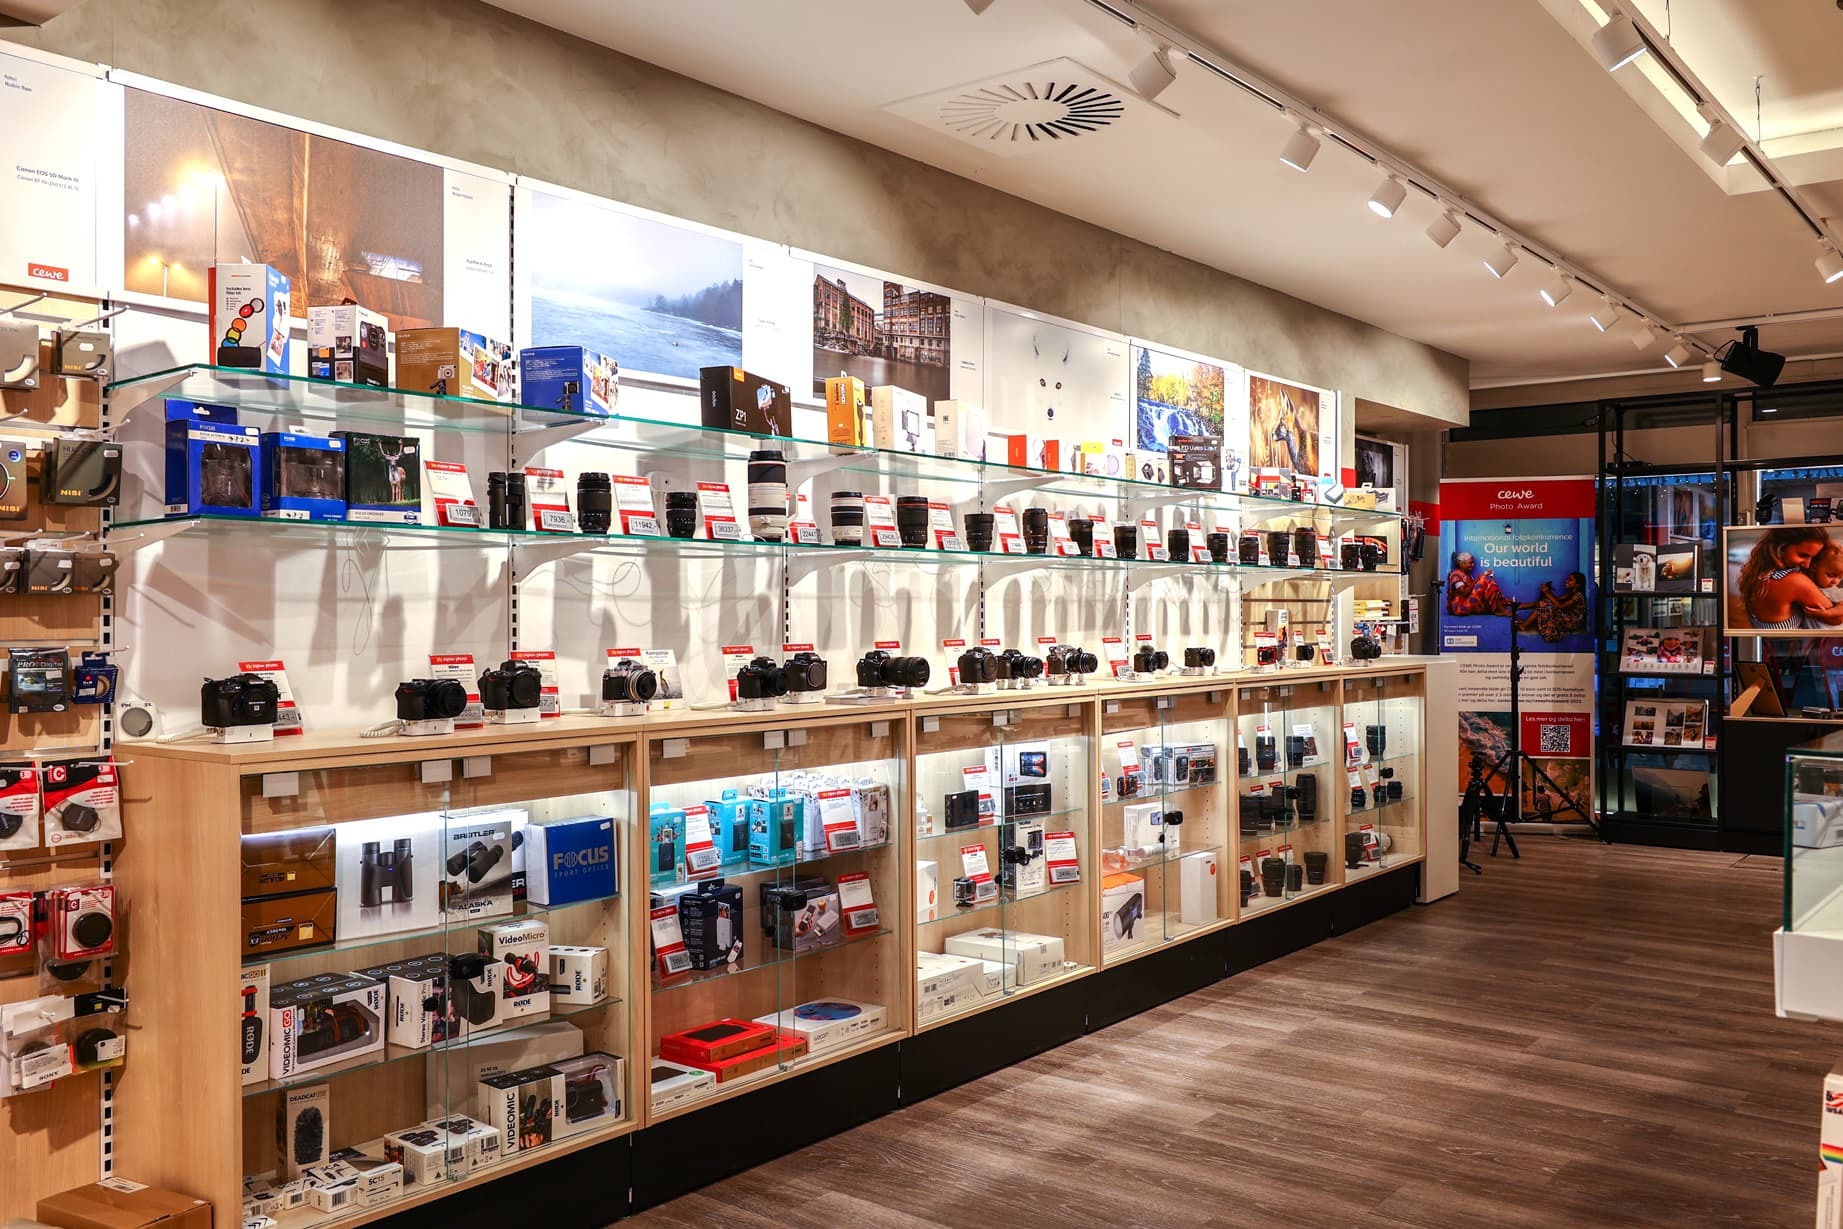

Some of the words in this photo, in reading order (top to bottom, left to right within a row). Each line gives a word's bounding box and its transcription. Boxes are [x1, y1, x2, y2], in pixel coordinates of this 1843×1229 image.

[16, 165, 36, 174] Canon
[36, 169, 48, 177] EOS
[58, 174, 72, 182] Mark
[32, 268, 64, 280] cewe
[1498, 490, 1534, 499] cewe
[1484, 543, 1507, 553] Our
[1511, 542, 1548, 553] world
[1480, 557, 1490, 567] is
[1494, 557, 1552, 567] beautiful
[554, 845, 609, 870] FOCUS
[458, 900, 493, 910] ALASKA
[499, 932, 545, 945] VideoMicro
[284, 1010, 291, 1027] GO
[283, 1028, 291, 1075] VIDEOMIC
[39, 1071, 59, 1080] SONY
[290, 1092, 316, 1102] DEADCAT
[507, 1092, 516, 1149] VIDEOMIC
[368, 1175, 385, 1185] SC15
